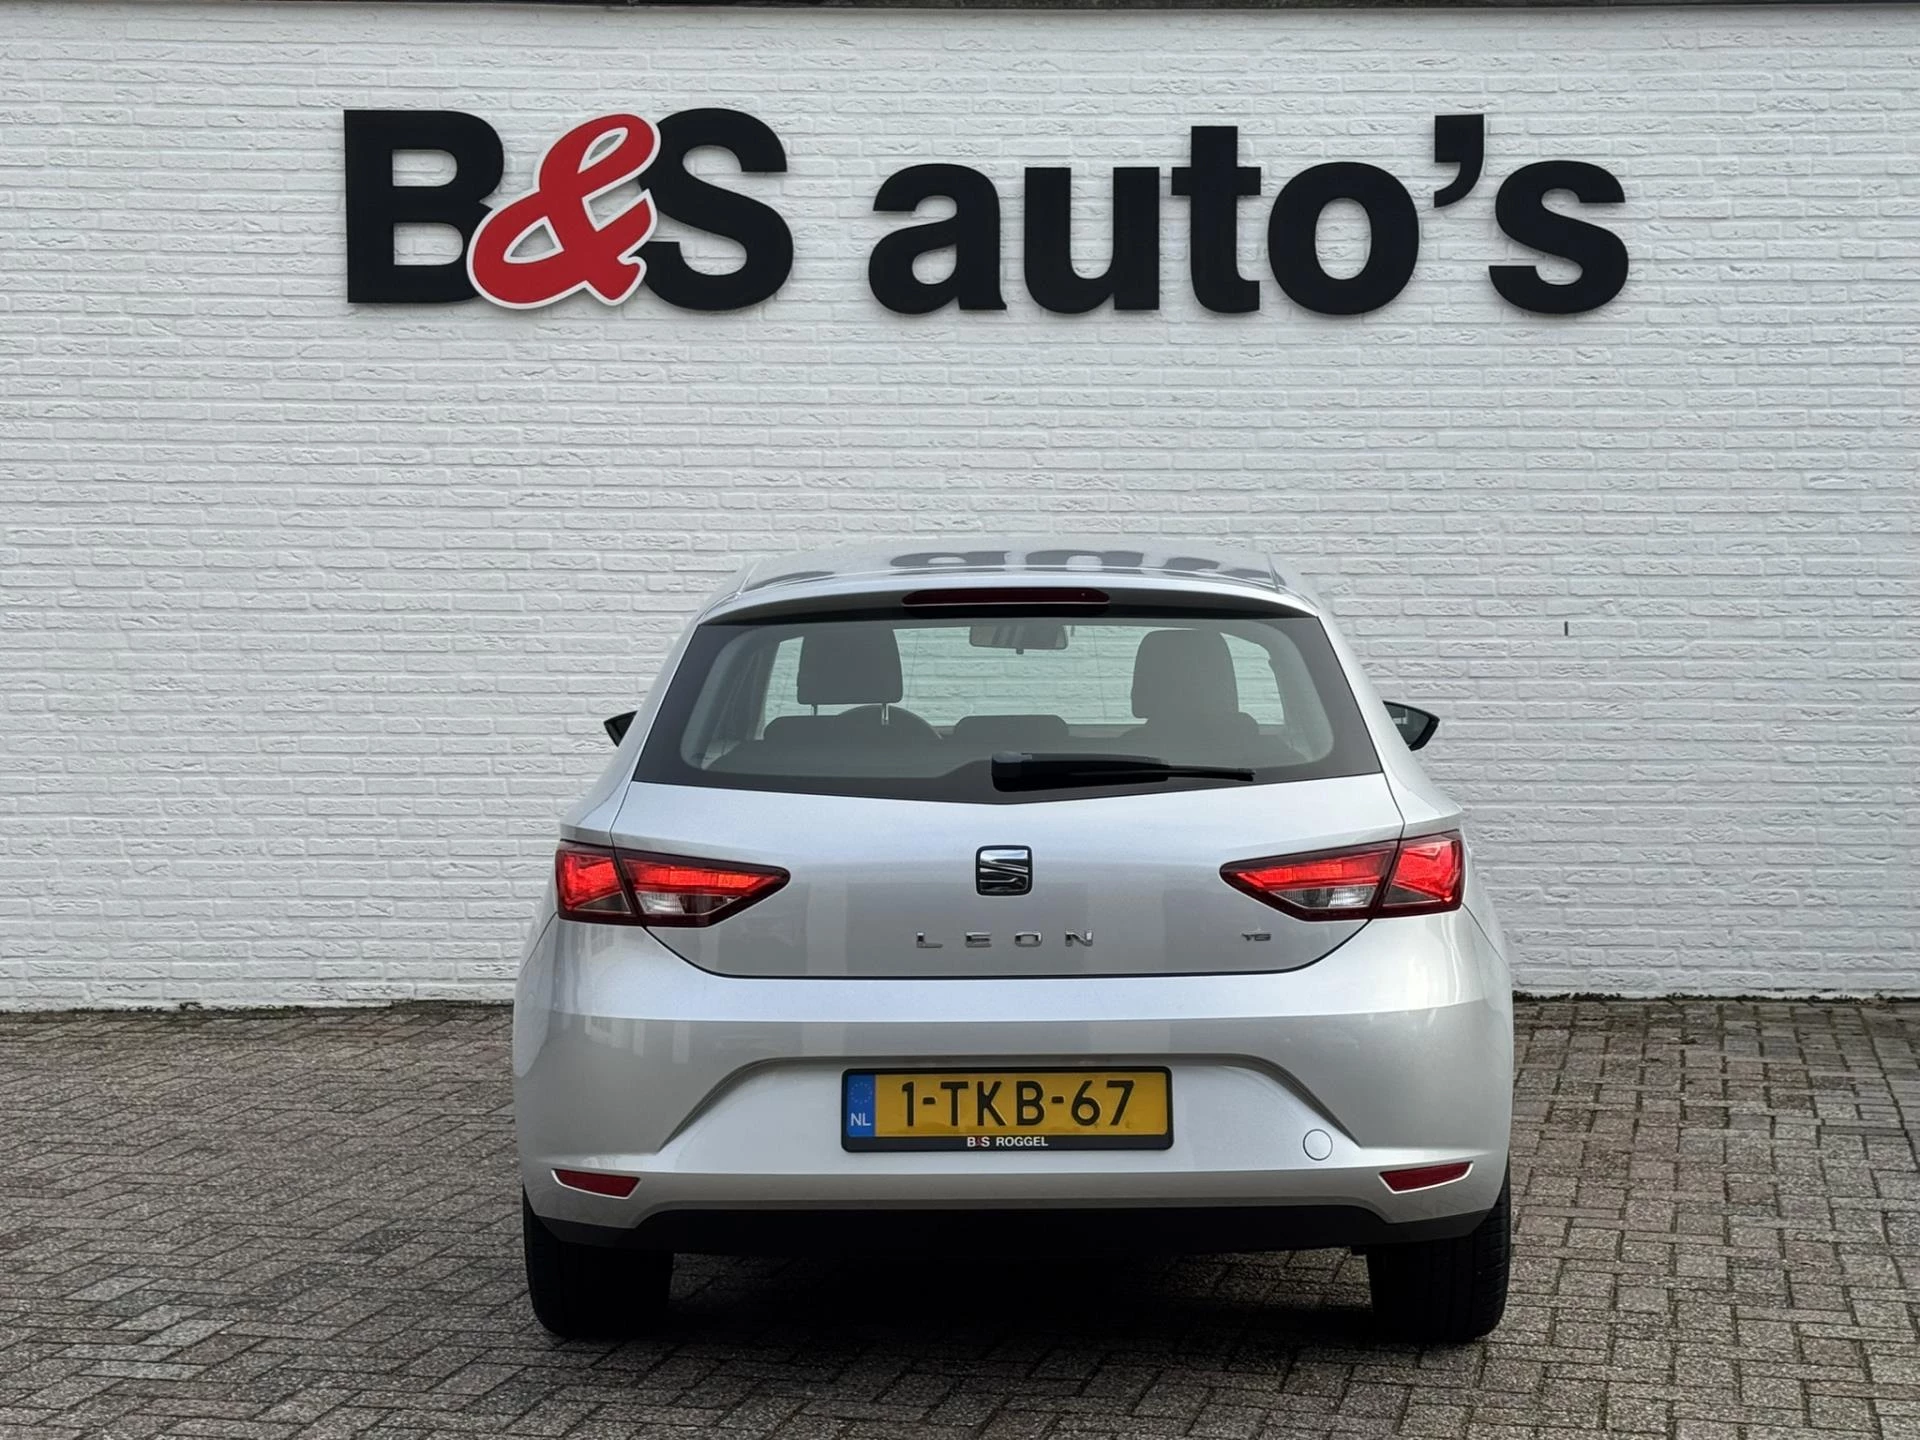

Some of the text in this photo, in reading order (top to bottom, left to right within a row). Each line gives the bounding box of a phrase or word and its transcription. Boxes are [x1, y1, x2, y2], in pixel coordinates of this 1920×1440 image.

[344, 108, 1629, 315] B&S auto's
[917, 931, 1093, 948] LEON
[902, 1080, 1135, 1126] 1-TKB-67
[850, 1112, 871, 1126] NL
[996, 1136, 1049, 1147] ROGGEL
